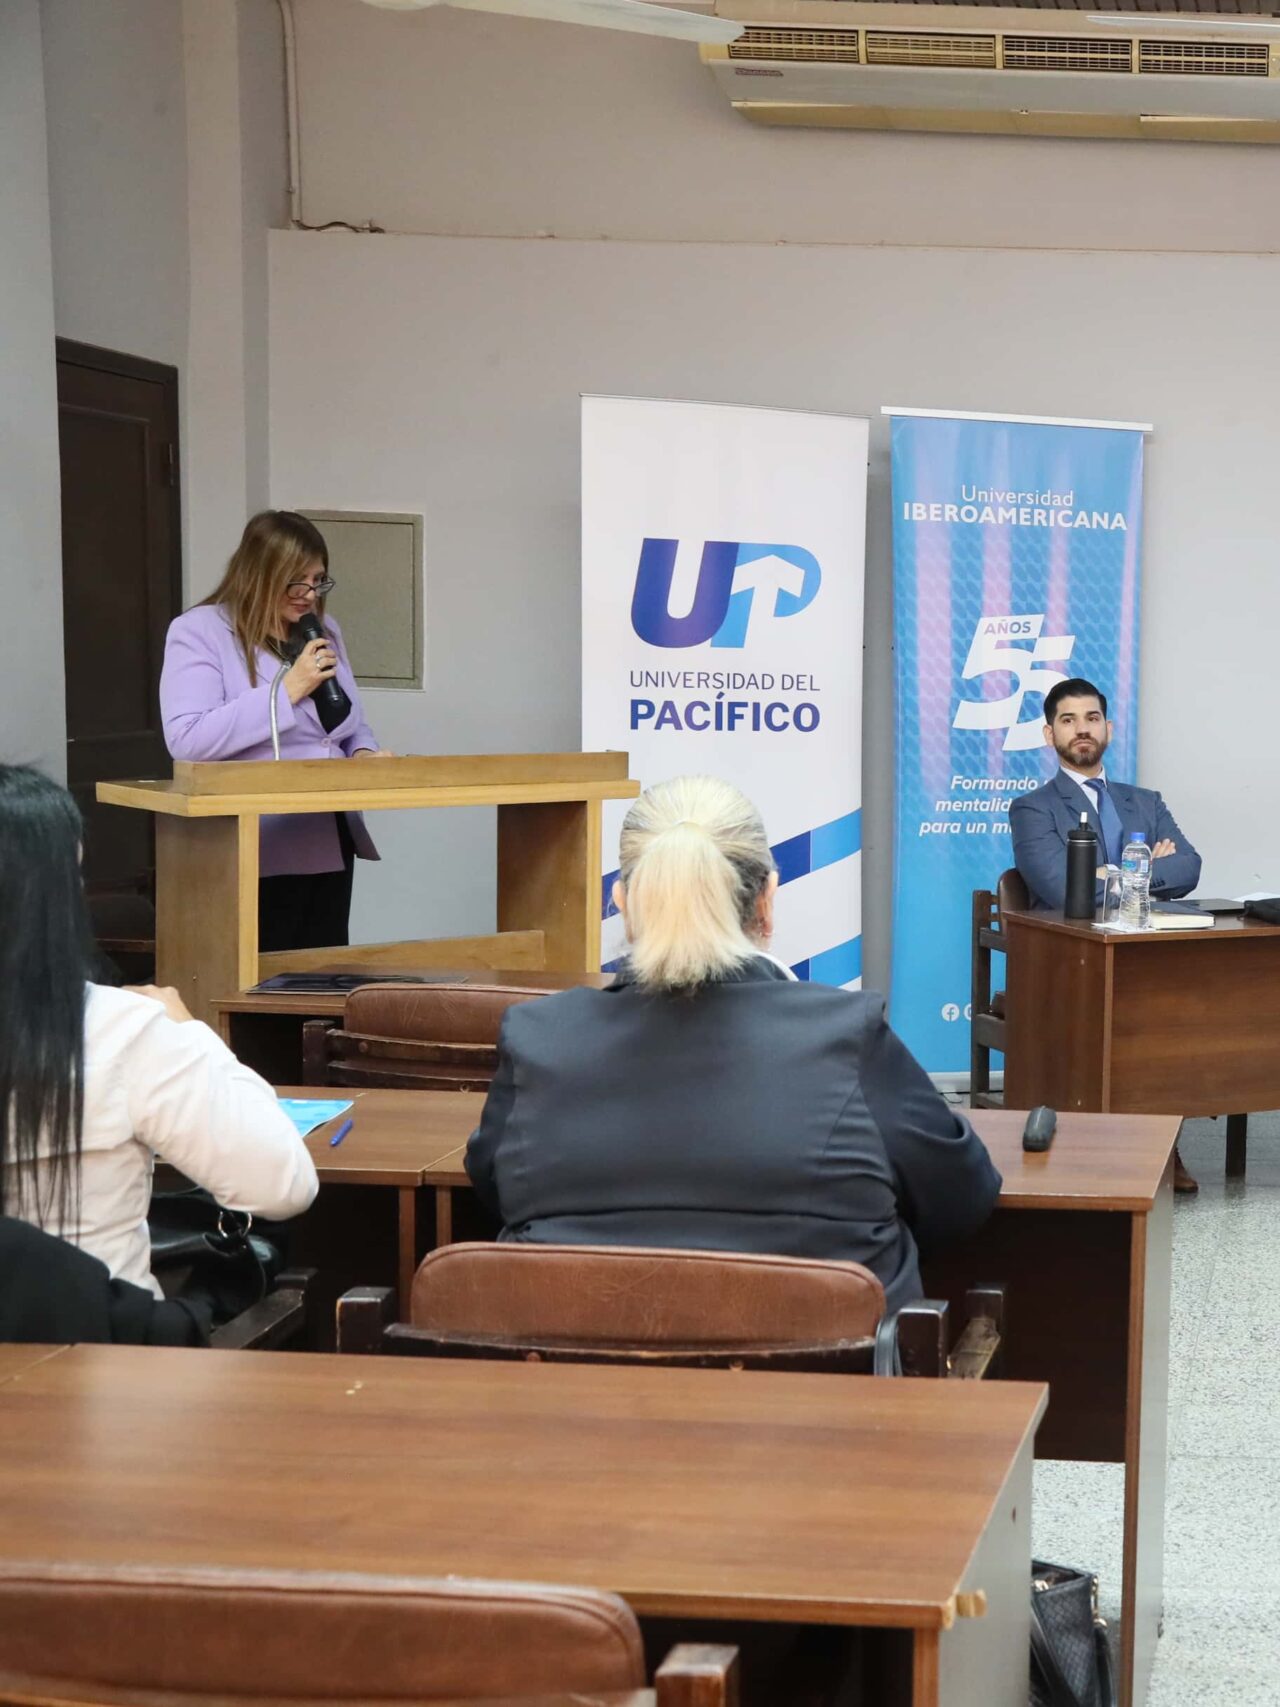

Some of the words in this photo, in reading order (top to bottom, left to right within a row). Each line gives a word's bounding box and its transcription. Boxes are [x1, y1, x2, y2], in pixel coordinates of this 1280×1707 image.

[962, 484, 1074, 507] Universidad
[903, 502, 1128, 531] IBEROAMERICANA
[631, 538, 822, 649] UP
[984, 619, 1031, 635] AÑOS
[629, 670, 775, 690] UNIVERSIDAD
[781, 674, 821, 692] DEL
[629, 691, 820, 733] PACÍFICO
[951, 775, 1039, 791] Formando
[918, 821, 961, 837] para
[966, 822, 987, 834] un
